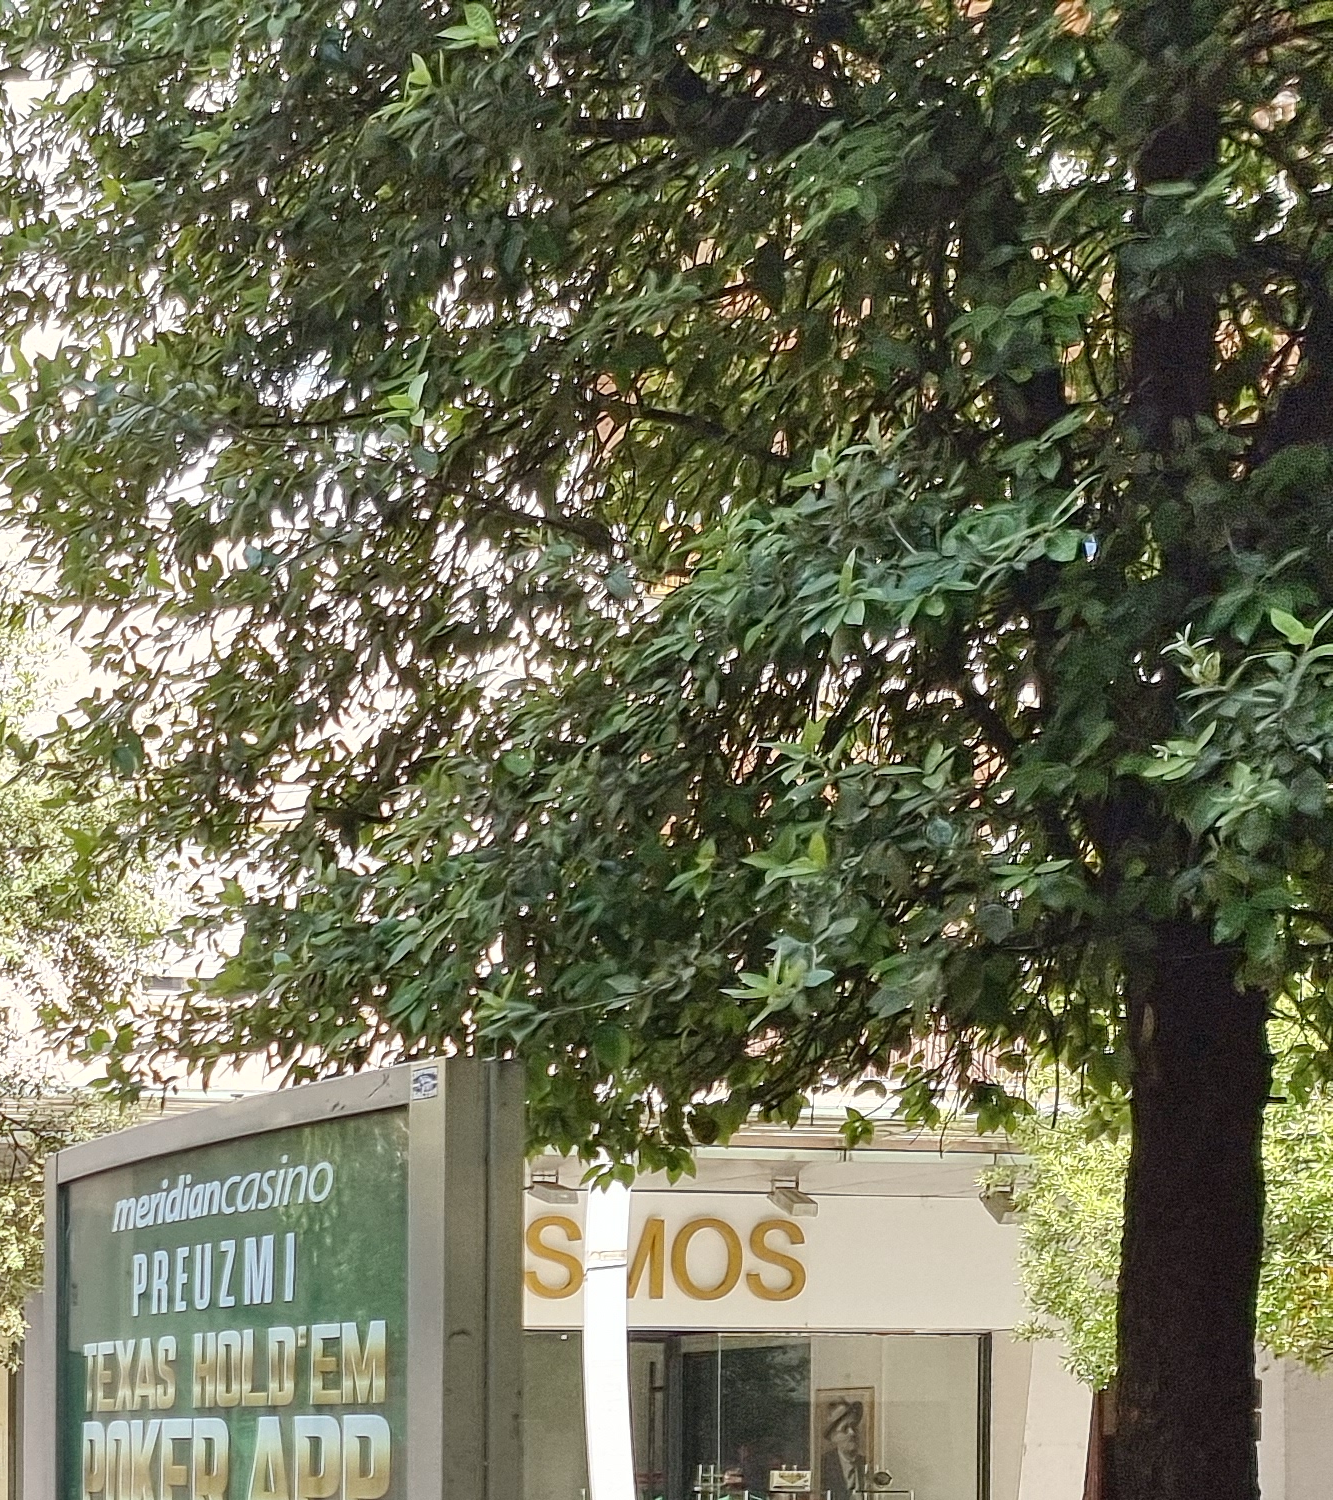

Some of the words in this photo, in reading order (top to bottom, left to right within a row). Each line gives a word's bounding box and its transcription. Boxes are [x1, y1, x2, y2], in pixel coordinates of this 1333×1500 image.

[111, 1154, 334, 1234] meridiancasino
[132, 1231, 297, 1318] PREUZMI
[81, 1334, 177, 1413] TEXAS
[192, 1319, 387, 1409] HOLD'EM
